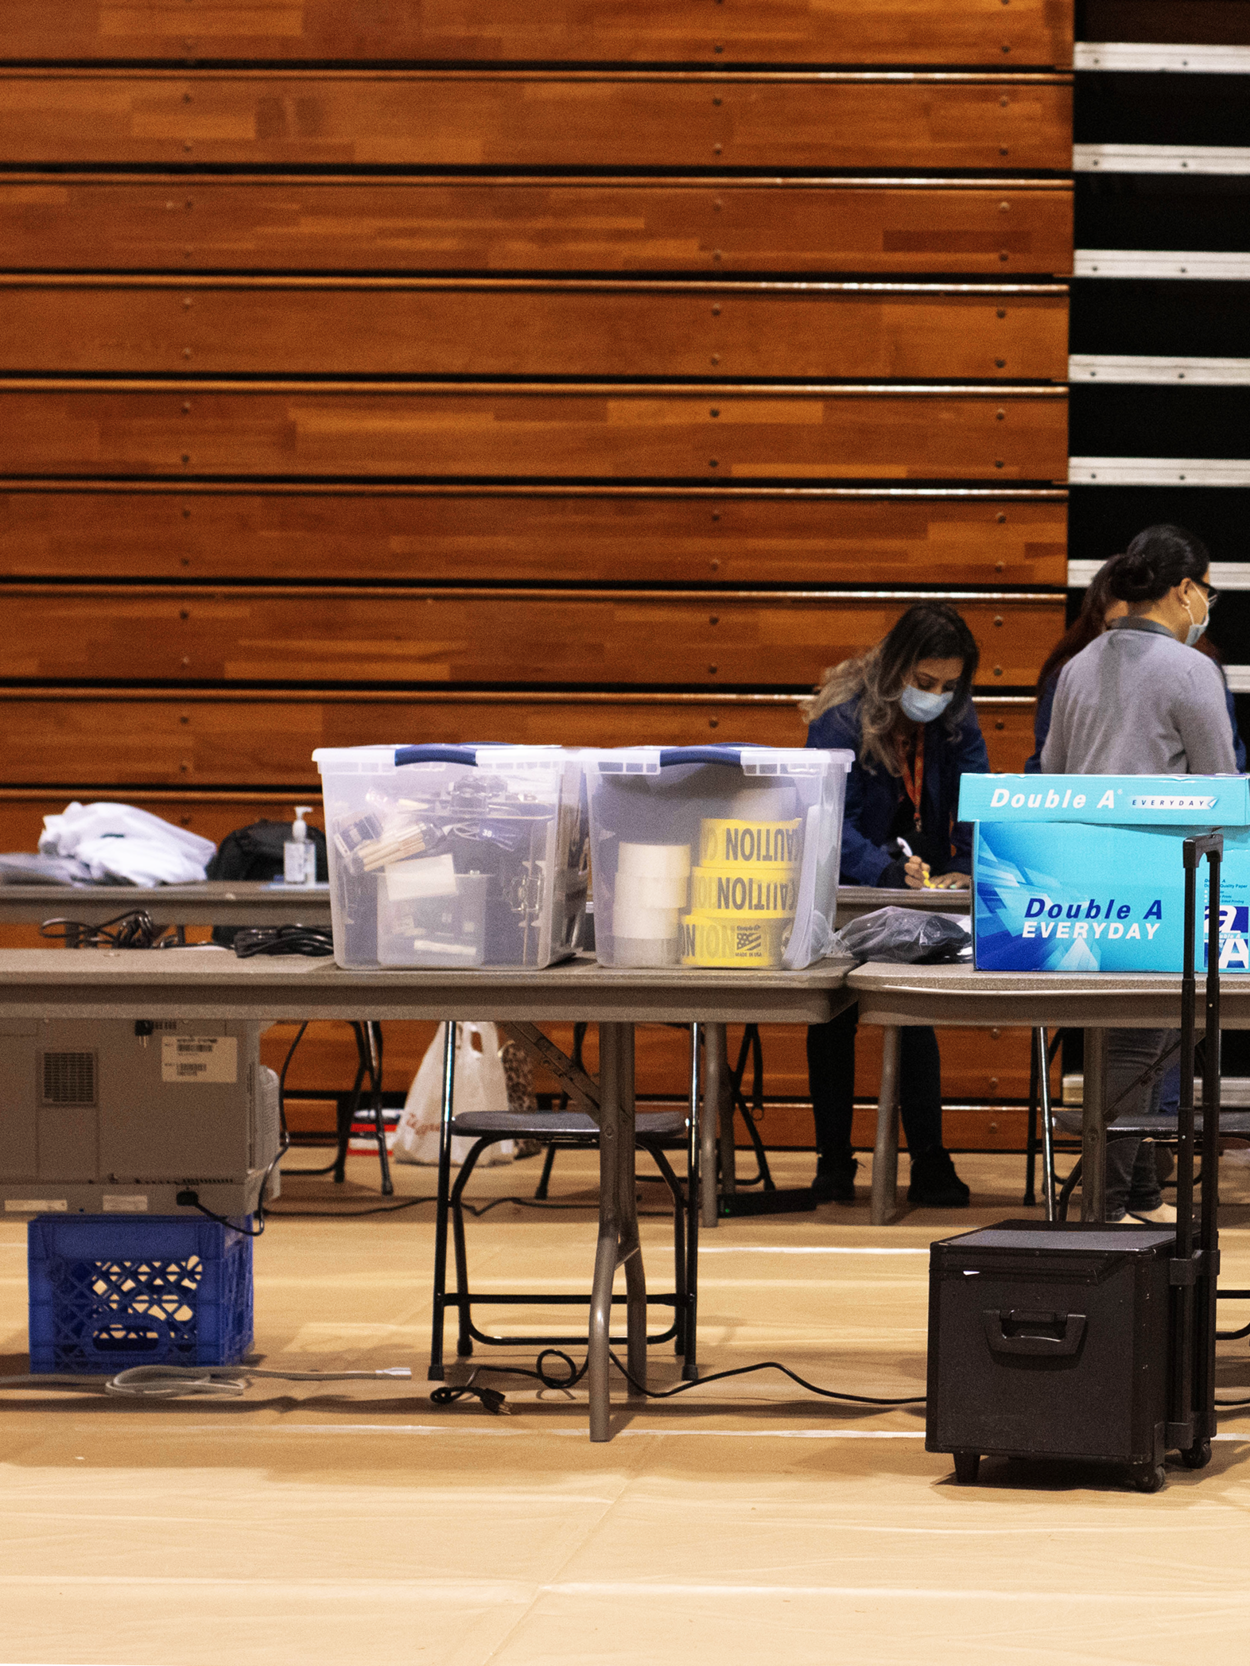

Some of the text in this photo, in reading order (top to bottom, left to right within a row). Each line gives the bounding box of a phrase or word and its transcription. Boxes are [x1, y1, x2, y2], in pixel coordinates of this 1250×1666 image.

[990, 788, 1115, 809] Double A
[1131, 799, 1205, 807] EVERYDAY
[725, 827, 799, 862] AUTION
[1024, 898, 1163, 920] Double A
[1021, 921, 1161, 940] EVERYDAY
